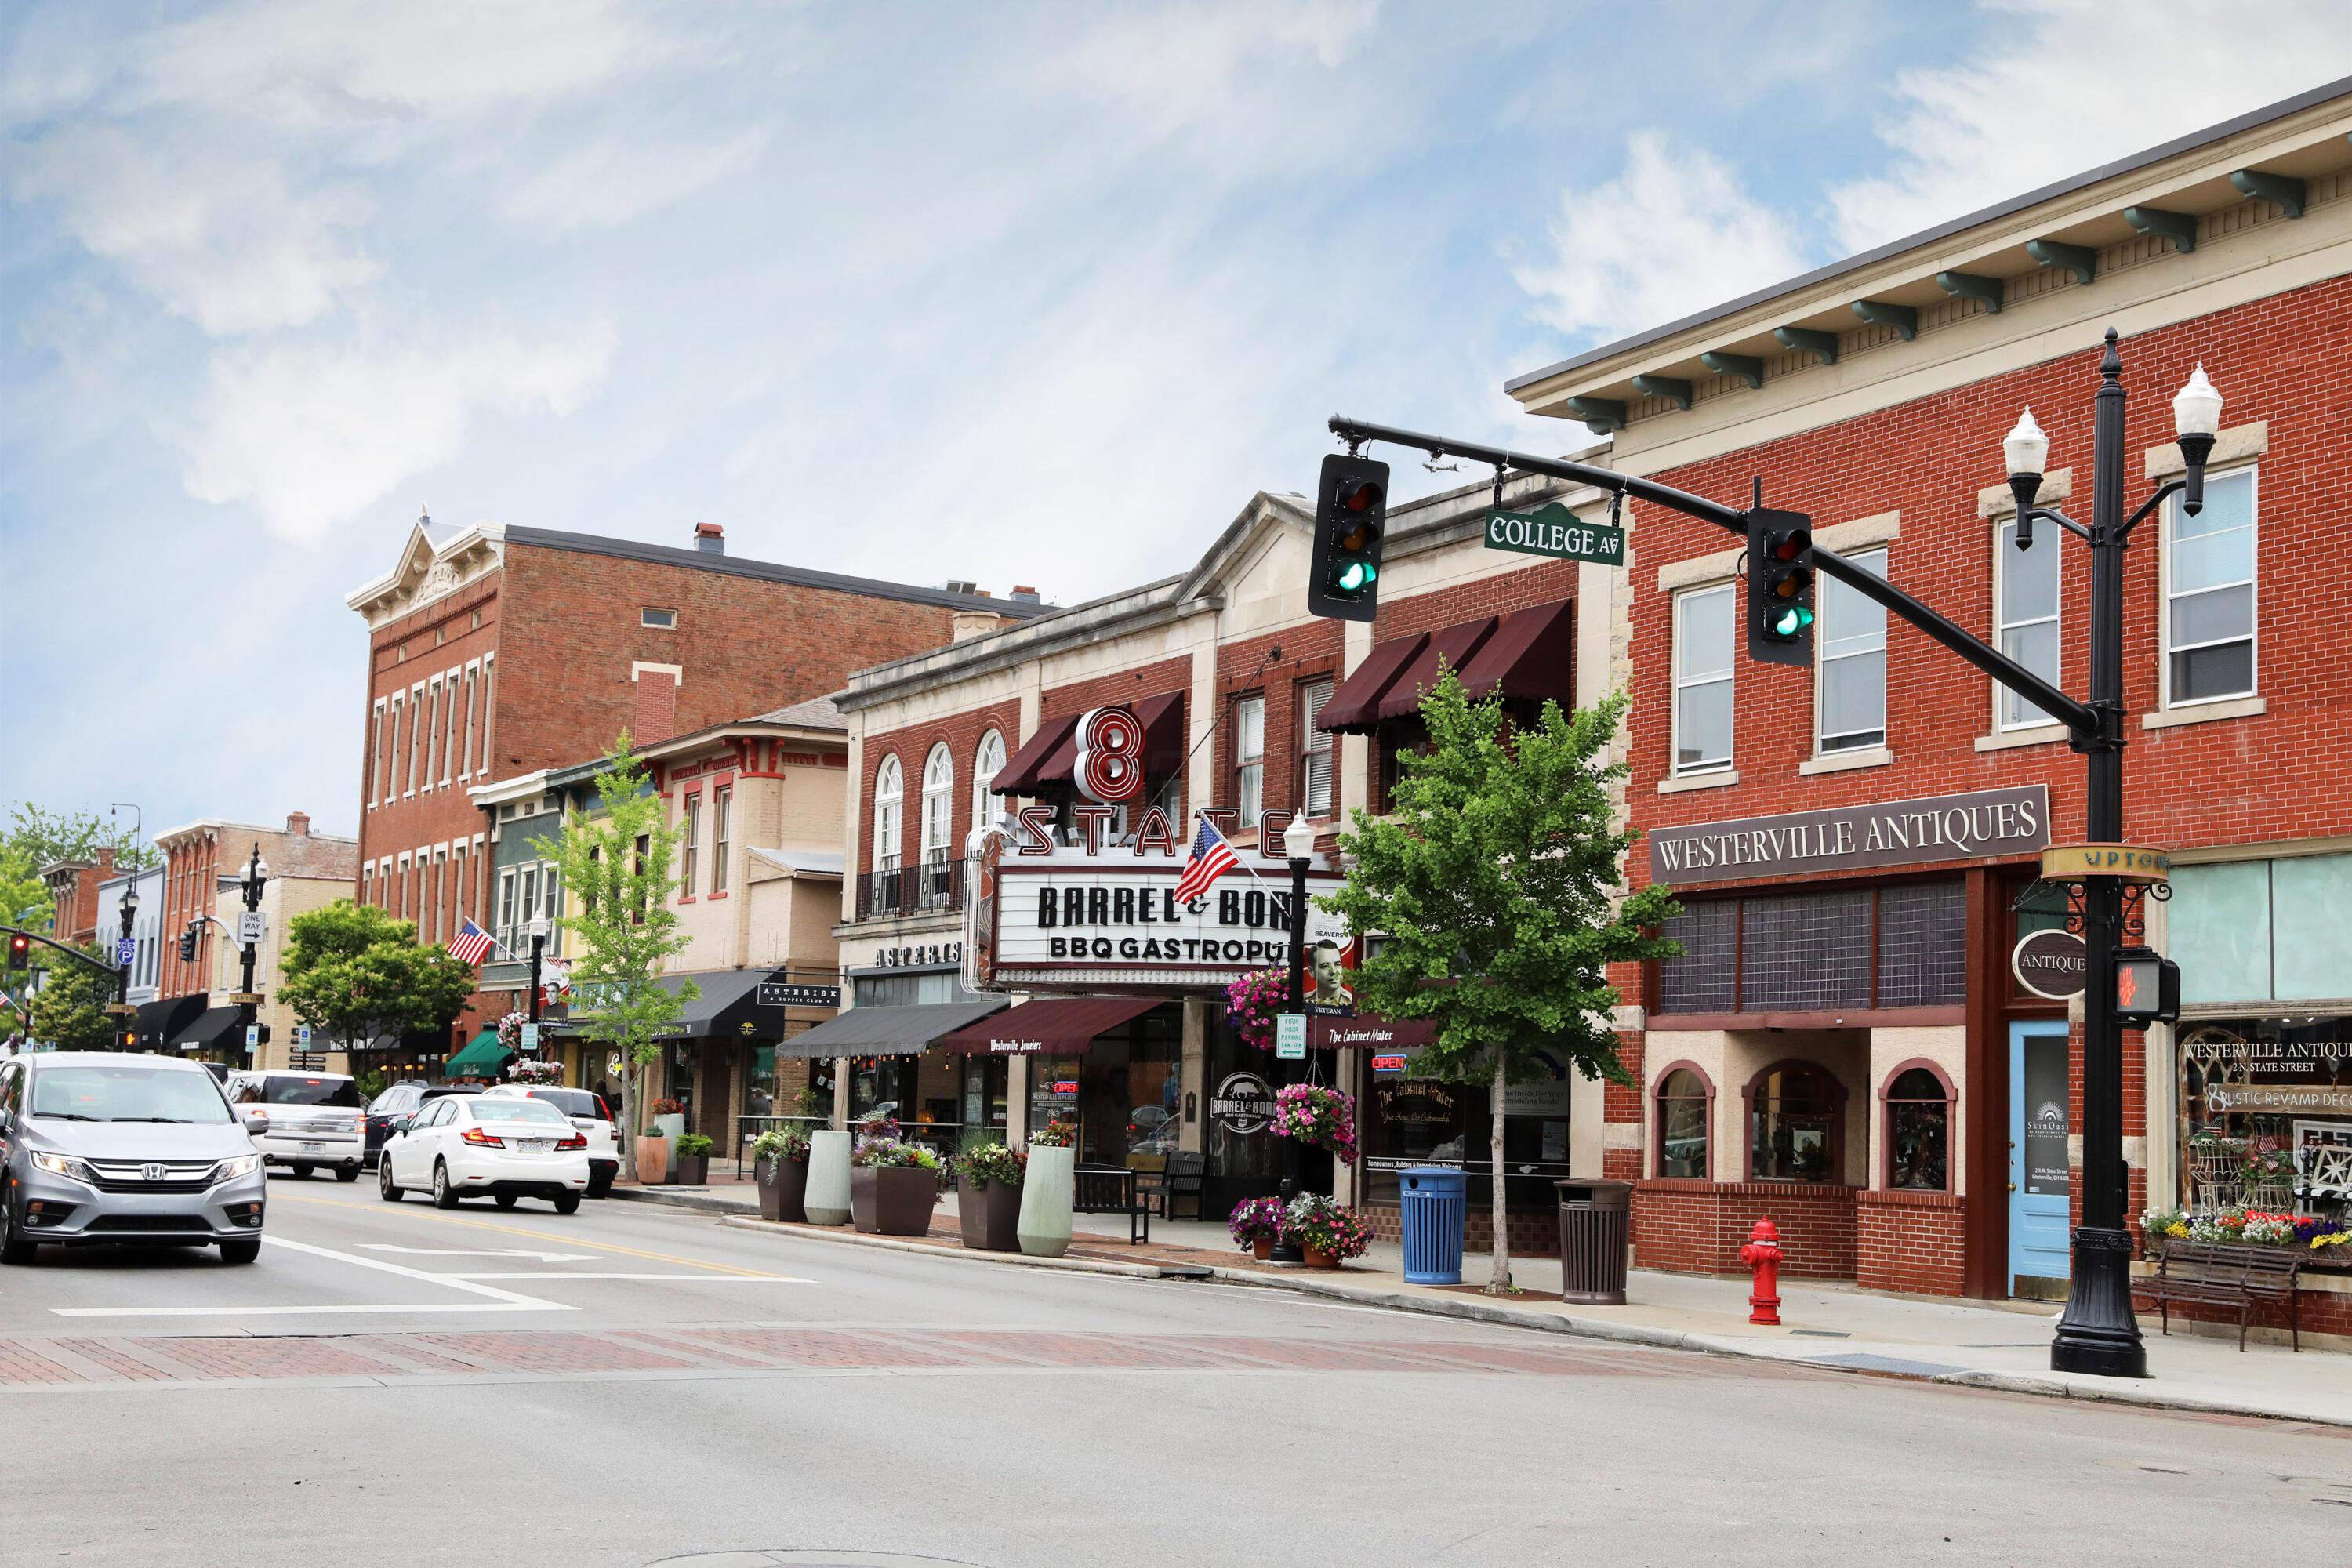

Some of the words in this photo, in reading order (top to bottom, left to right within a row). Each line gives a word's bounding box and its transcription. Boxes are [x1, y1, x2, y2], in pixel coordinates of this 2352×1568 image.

[1490, 517, 1595, 555] COLLEGE
[1076, 706, 1145, 801] 8
[1019, 805, 1292, 859] STATE
[1658, 821, 1856, 872] WESTERVILLE
[1863, 800, 2037, 853] ANTIQUES
[1038, 887, 1181, 928] BARREL
[1187, 893, 1210, 914] &
[1219, 890, 1309, 931] BOA
[1051, 937, 1112, 959] BBQ
[1119, 938, 1292, 962] GASTROPU
[2022, 954, 2085, 973] ANTIQUE
[764, 988, 837, 996] ASTERISK
[1330, 1029, 1344, 1044] The
[1343, 1029, 1369, 1044] Cabinet
[1370, 1028, 1393, 1043] Maker
[990, 1039, 1018, 1051] Westerville
[1020, 1039, 1042, 1051] Jewelers
[2183, 1043, 2283, 1058] WESTERVILLE
[1372, 1057, 1406, 1069] OPEN
[2250, 1062, 2278, 1072] STATE
[2280, 1062, 2315, 1072] STREET
[1054, 1083, 1078, 1092] OPEN
[1213, 1099, 1246, 1114] BARREL
[1377, 1090, 1392, 1108] The
[2265, 1093, 2318, 1106] REVAMP
